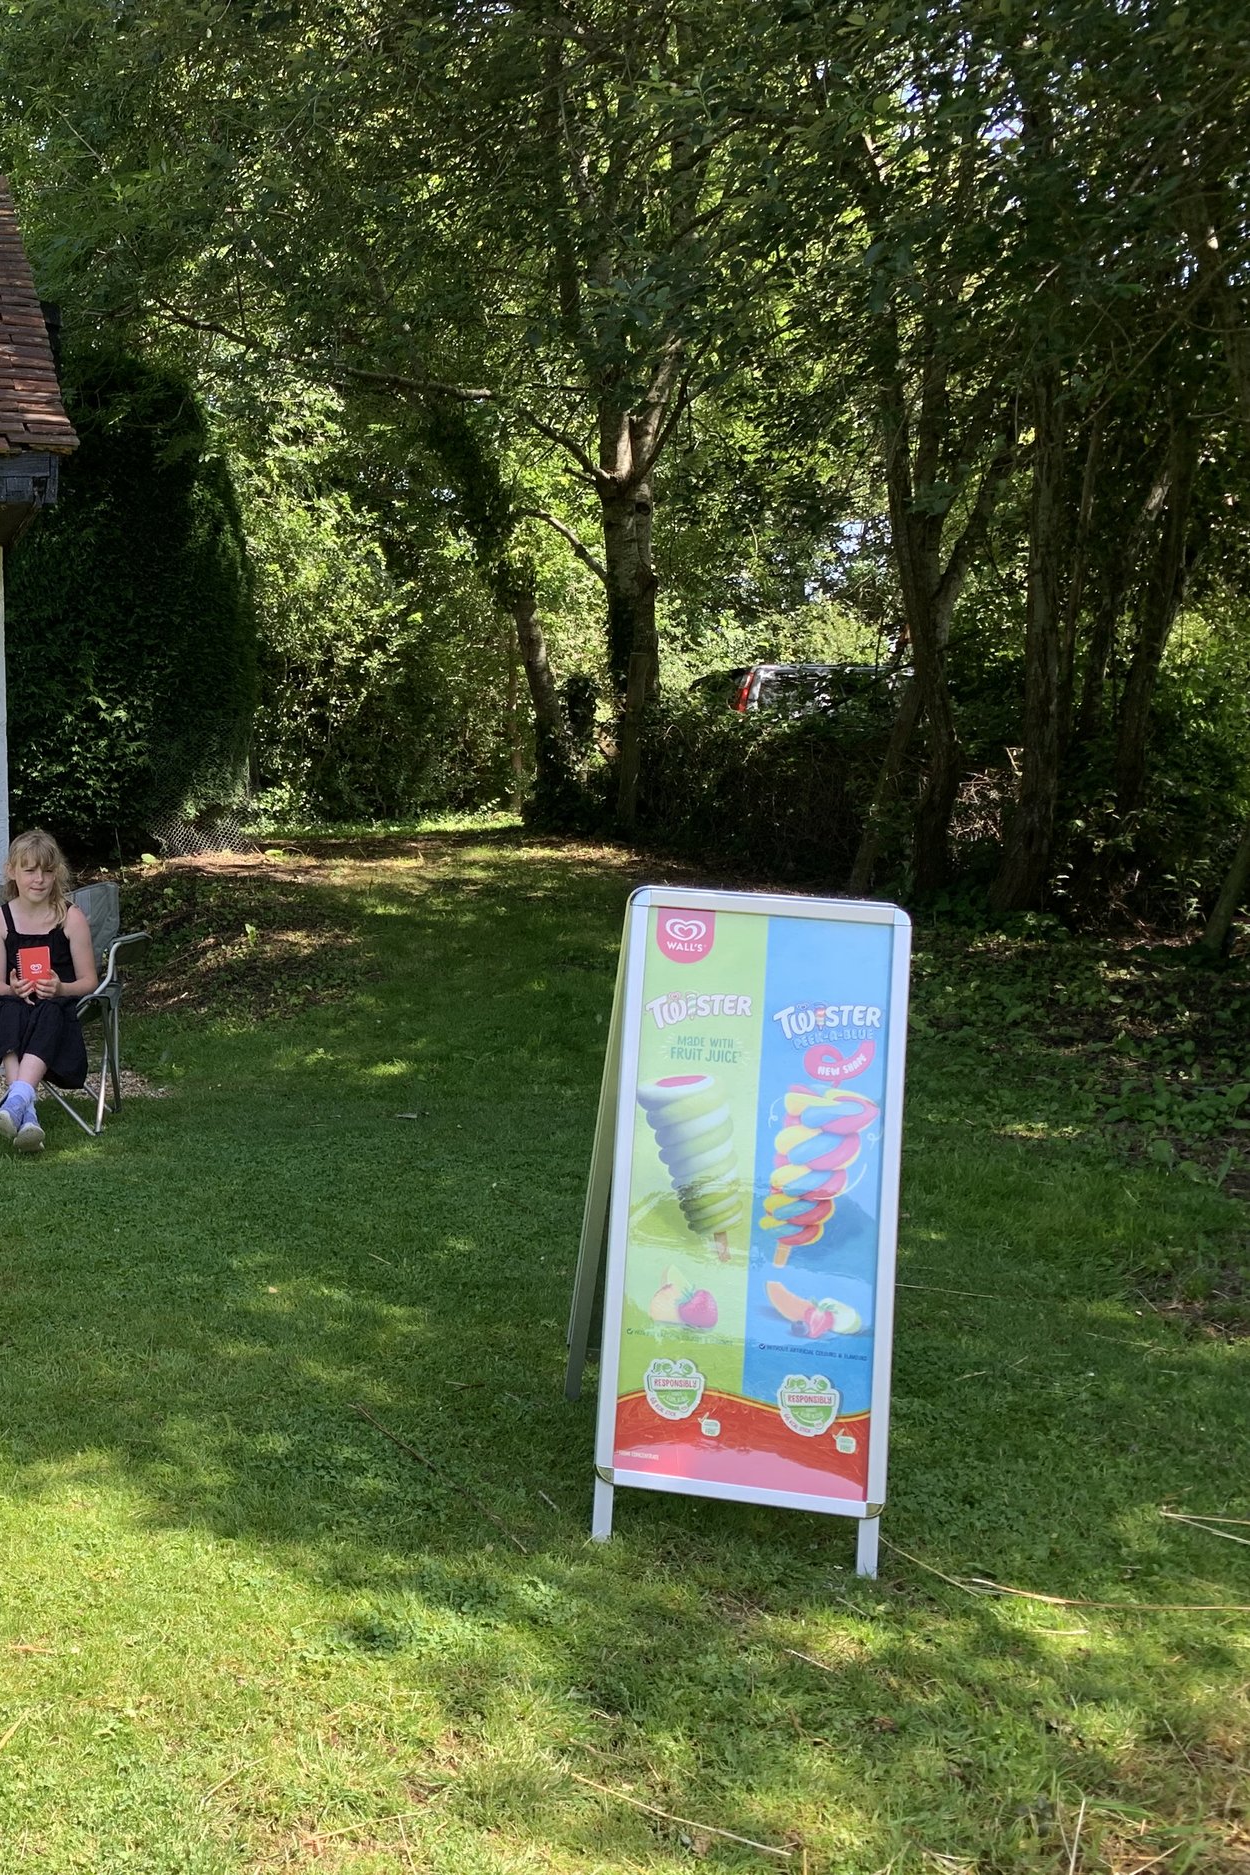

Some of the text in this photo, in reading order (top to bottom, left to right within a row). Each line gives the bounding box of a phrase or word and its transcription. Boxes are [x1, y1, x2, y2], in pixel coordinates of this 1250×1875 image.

[666, 940, 704, 953] WALL'S
[645, 991, 753, 1030] TWISTER
[773, 1001, 883, 1039] TWISTER
[710, 1037, 735, 1049] WITH
[792, 1028, 874, 1050] PEEK-A-BLUE
[817, 1053, 867, 1076] NEW SHAPE
[654, 1379, 697, 1389] RESPONSIBLY
[787, 1394, 832, 1404] RESPONSIBLY
